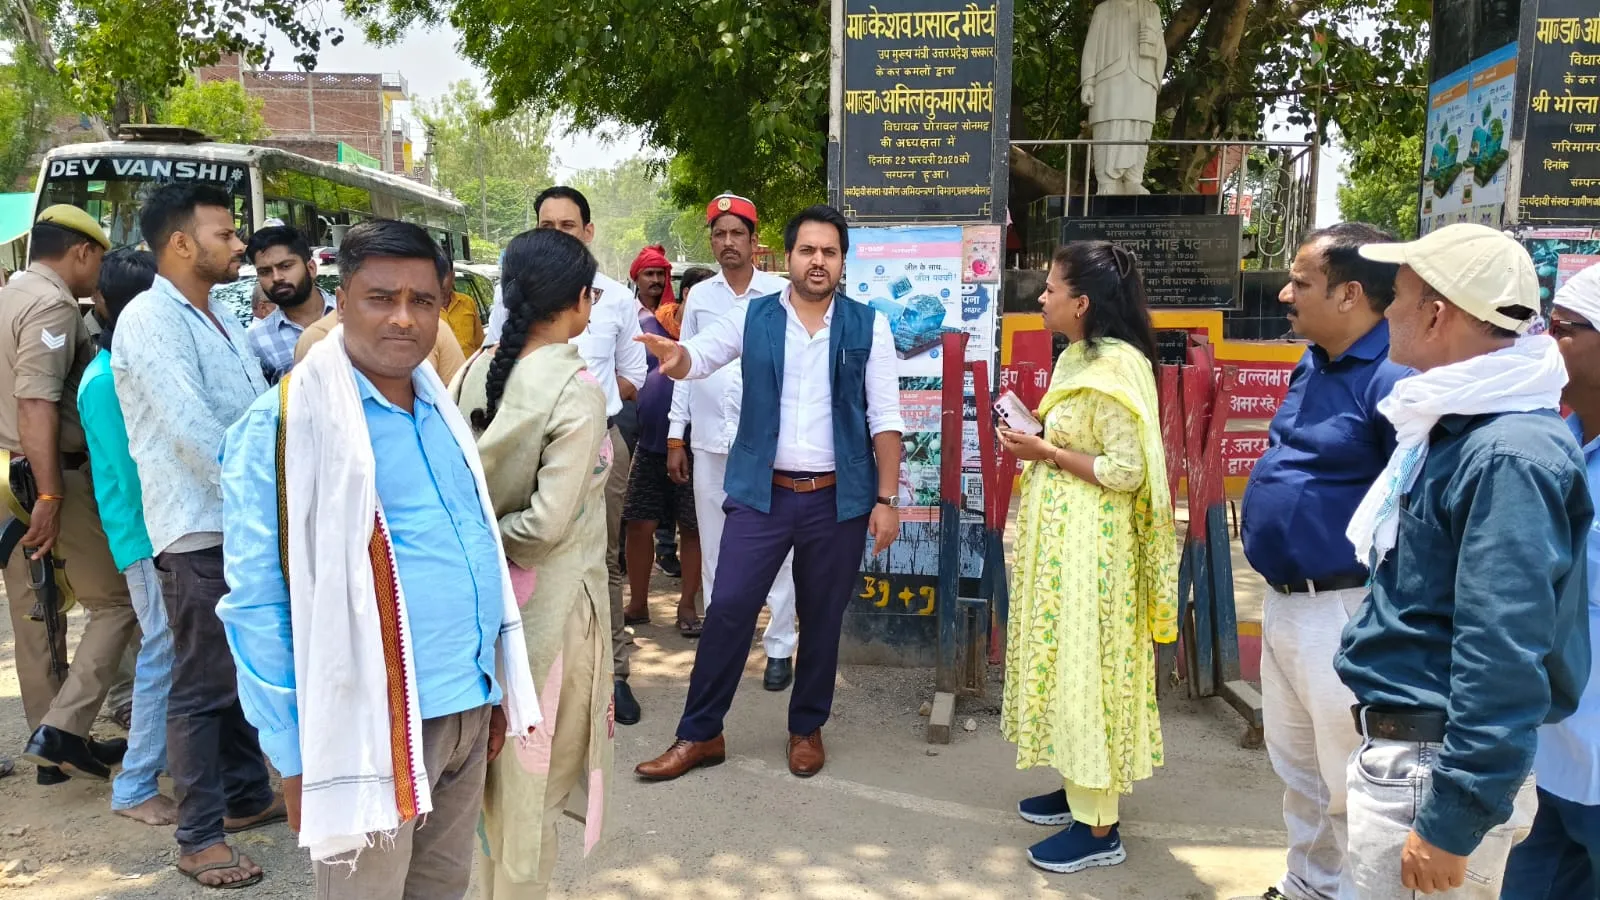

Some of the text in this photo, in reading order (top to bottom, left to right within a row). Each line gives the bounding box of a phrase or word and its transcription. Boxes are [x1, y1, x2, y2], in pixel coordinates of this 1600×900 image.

[1563, 71, 1598, 85] के कर
[1531, 89, 1551, 113] श्री
[880, 136, 893, 148] की
[946, 135, 957, 148] में
[868, 154, 894, 167] दिनांक
[895, 156, 906, 165] 22
[1543, 158, 1570, 171] दिनांक
[50, 159, 228, 182] DEV VANSHI
[1228, 395, 1260, 413] अमर
